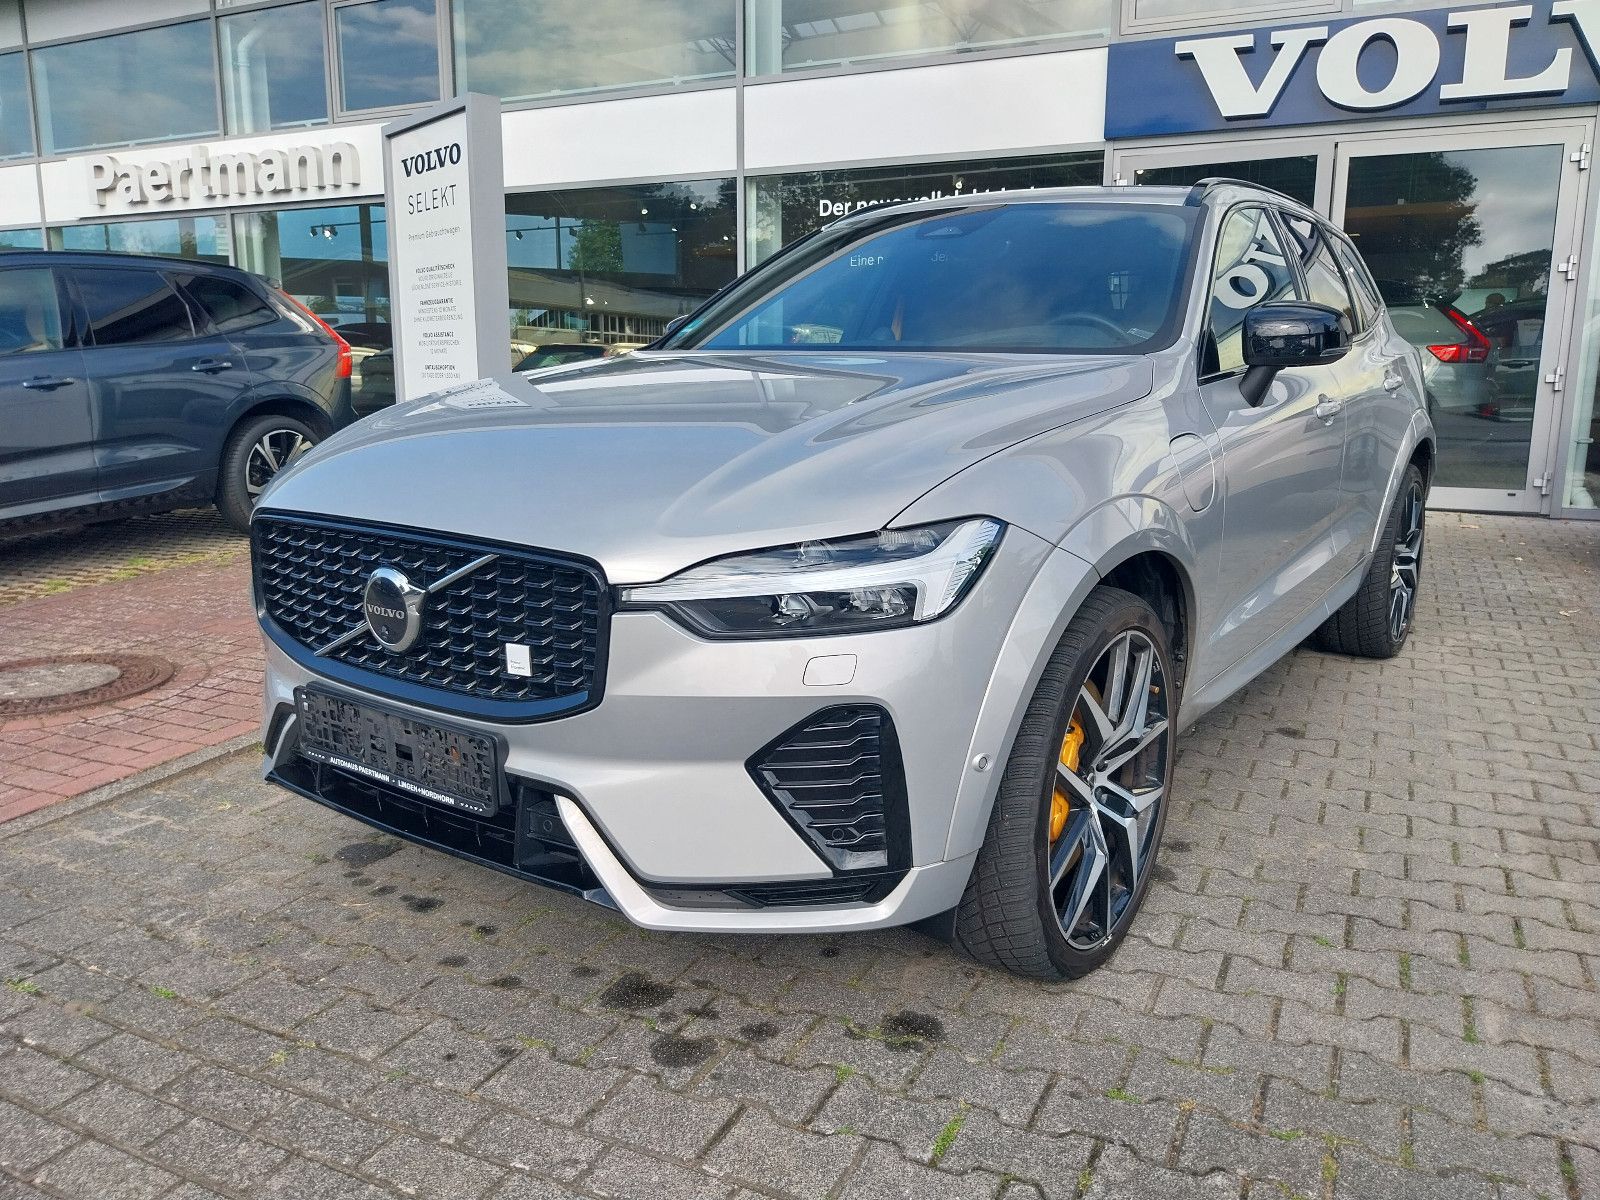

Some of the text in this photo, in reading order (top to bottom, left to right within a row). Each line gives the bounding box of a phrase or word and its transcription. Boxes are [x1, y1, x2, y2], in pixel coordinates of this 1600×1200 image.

[1174, 1, 1600, 118] VOL
[85, 142, 362, 207] Paertmann
[401, 142, 462, 178] VOLVO
[408, 184, 457, 215] SELEKT
[819, 199, 852, 217] Der
[850, 255, 874, 267] Eine
[366, 603, 405, 620] VOLVO
[330, 756, 455, 805] AUTOHAUS PAERTMANN LINGEN+NORDHORN
